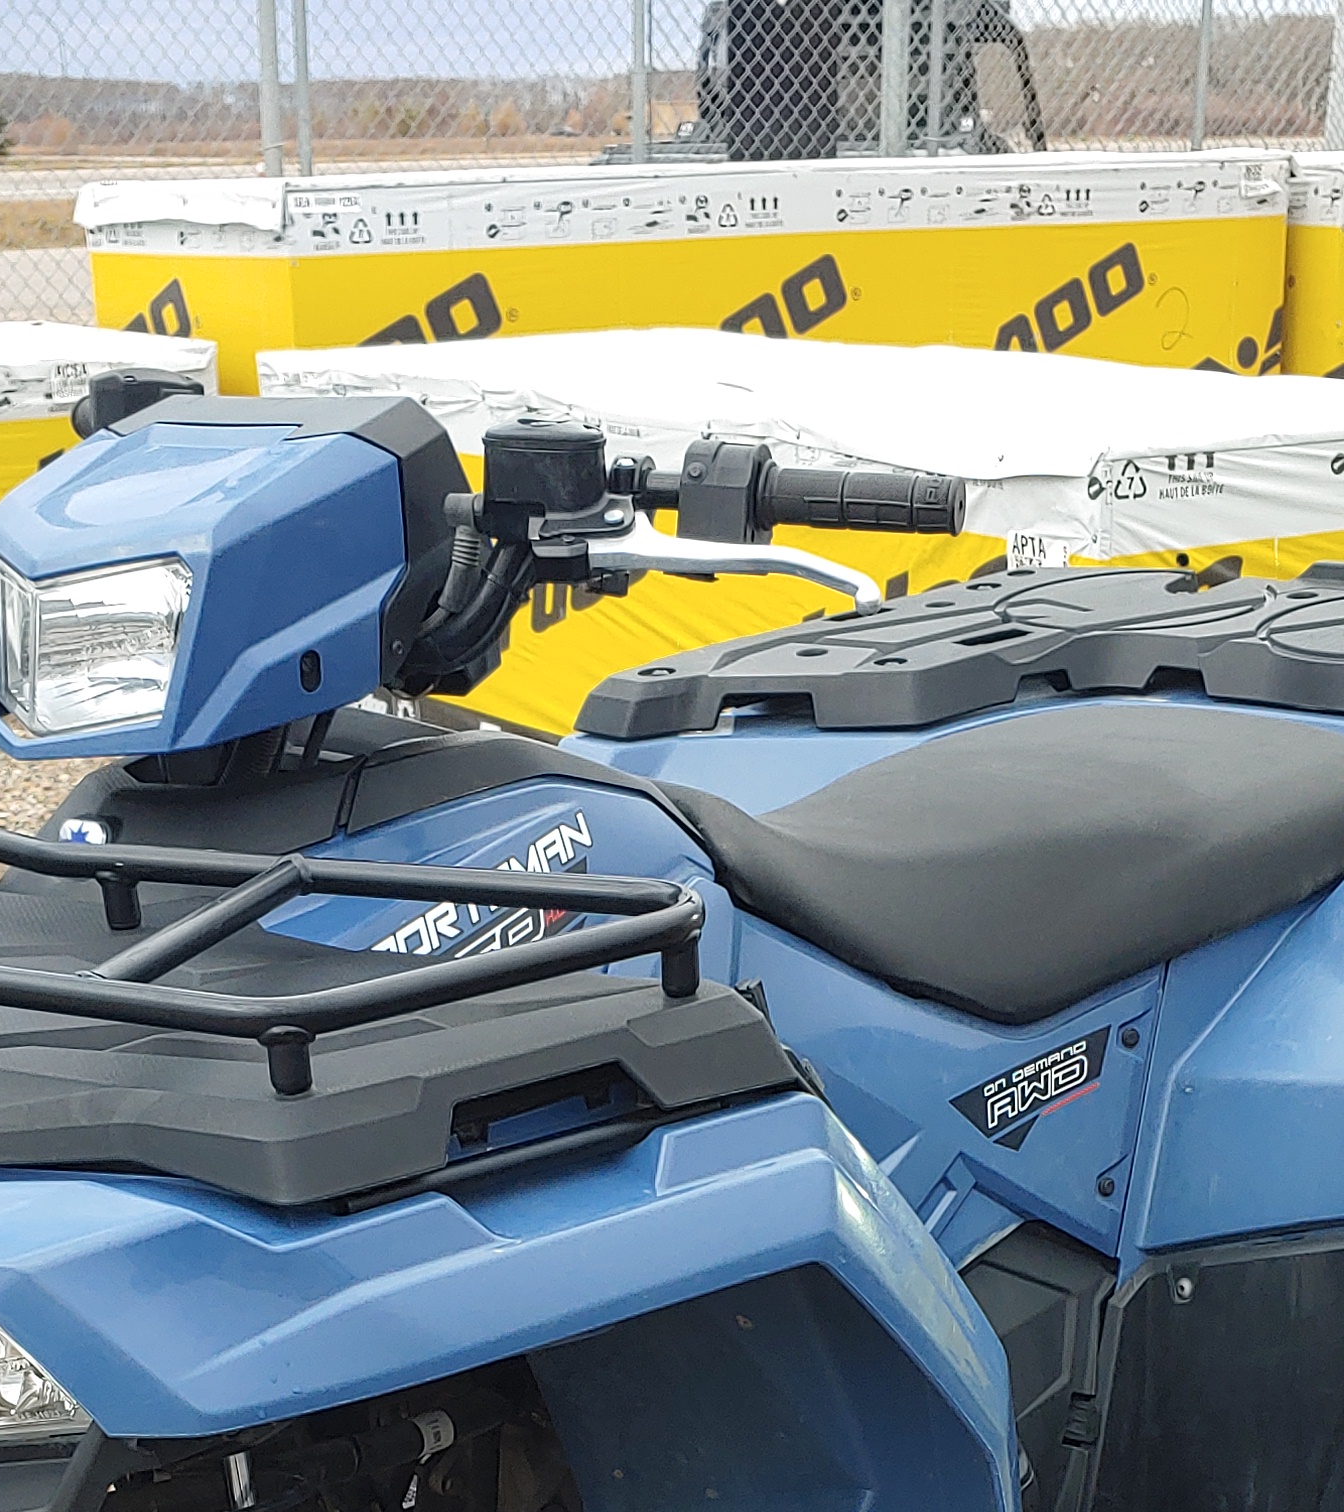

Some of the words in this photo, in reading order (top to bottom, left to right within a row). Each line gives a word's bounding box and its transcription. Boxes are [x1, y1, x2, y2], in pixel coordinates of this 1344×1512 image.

[1012, 532, 1047, 560] APTA
[983, 1077, 1006, 1097] ON
[1011, 1040, 1087, 1084] DEMAND
[986, 1055, 1089, 1129] AWD
